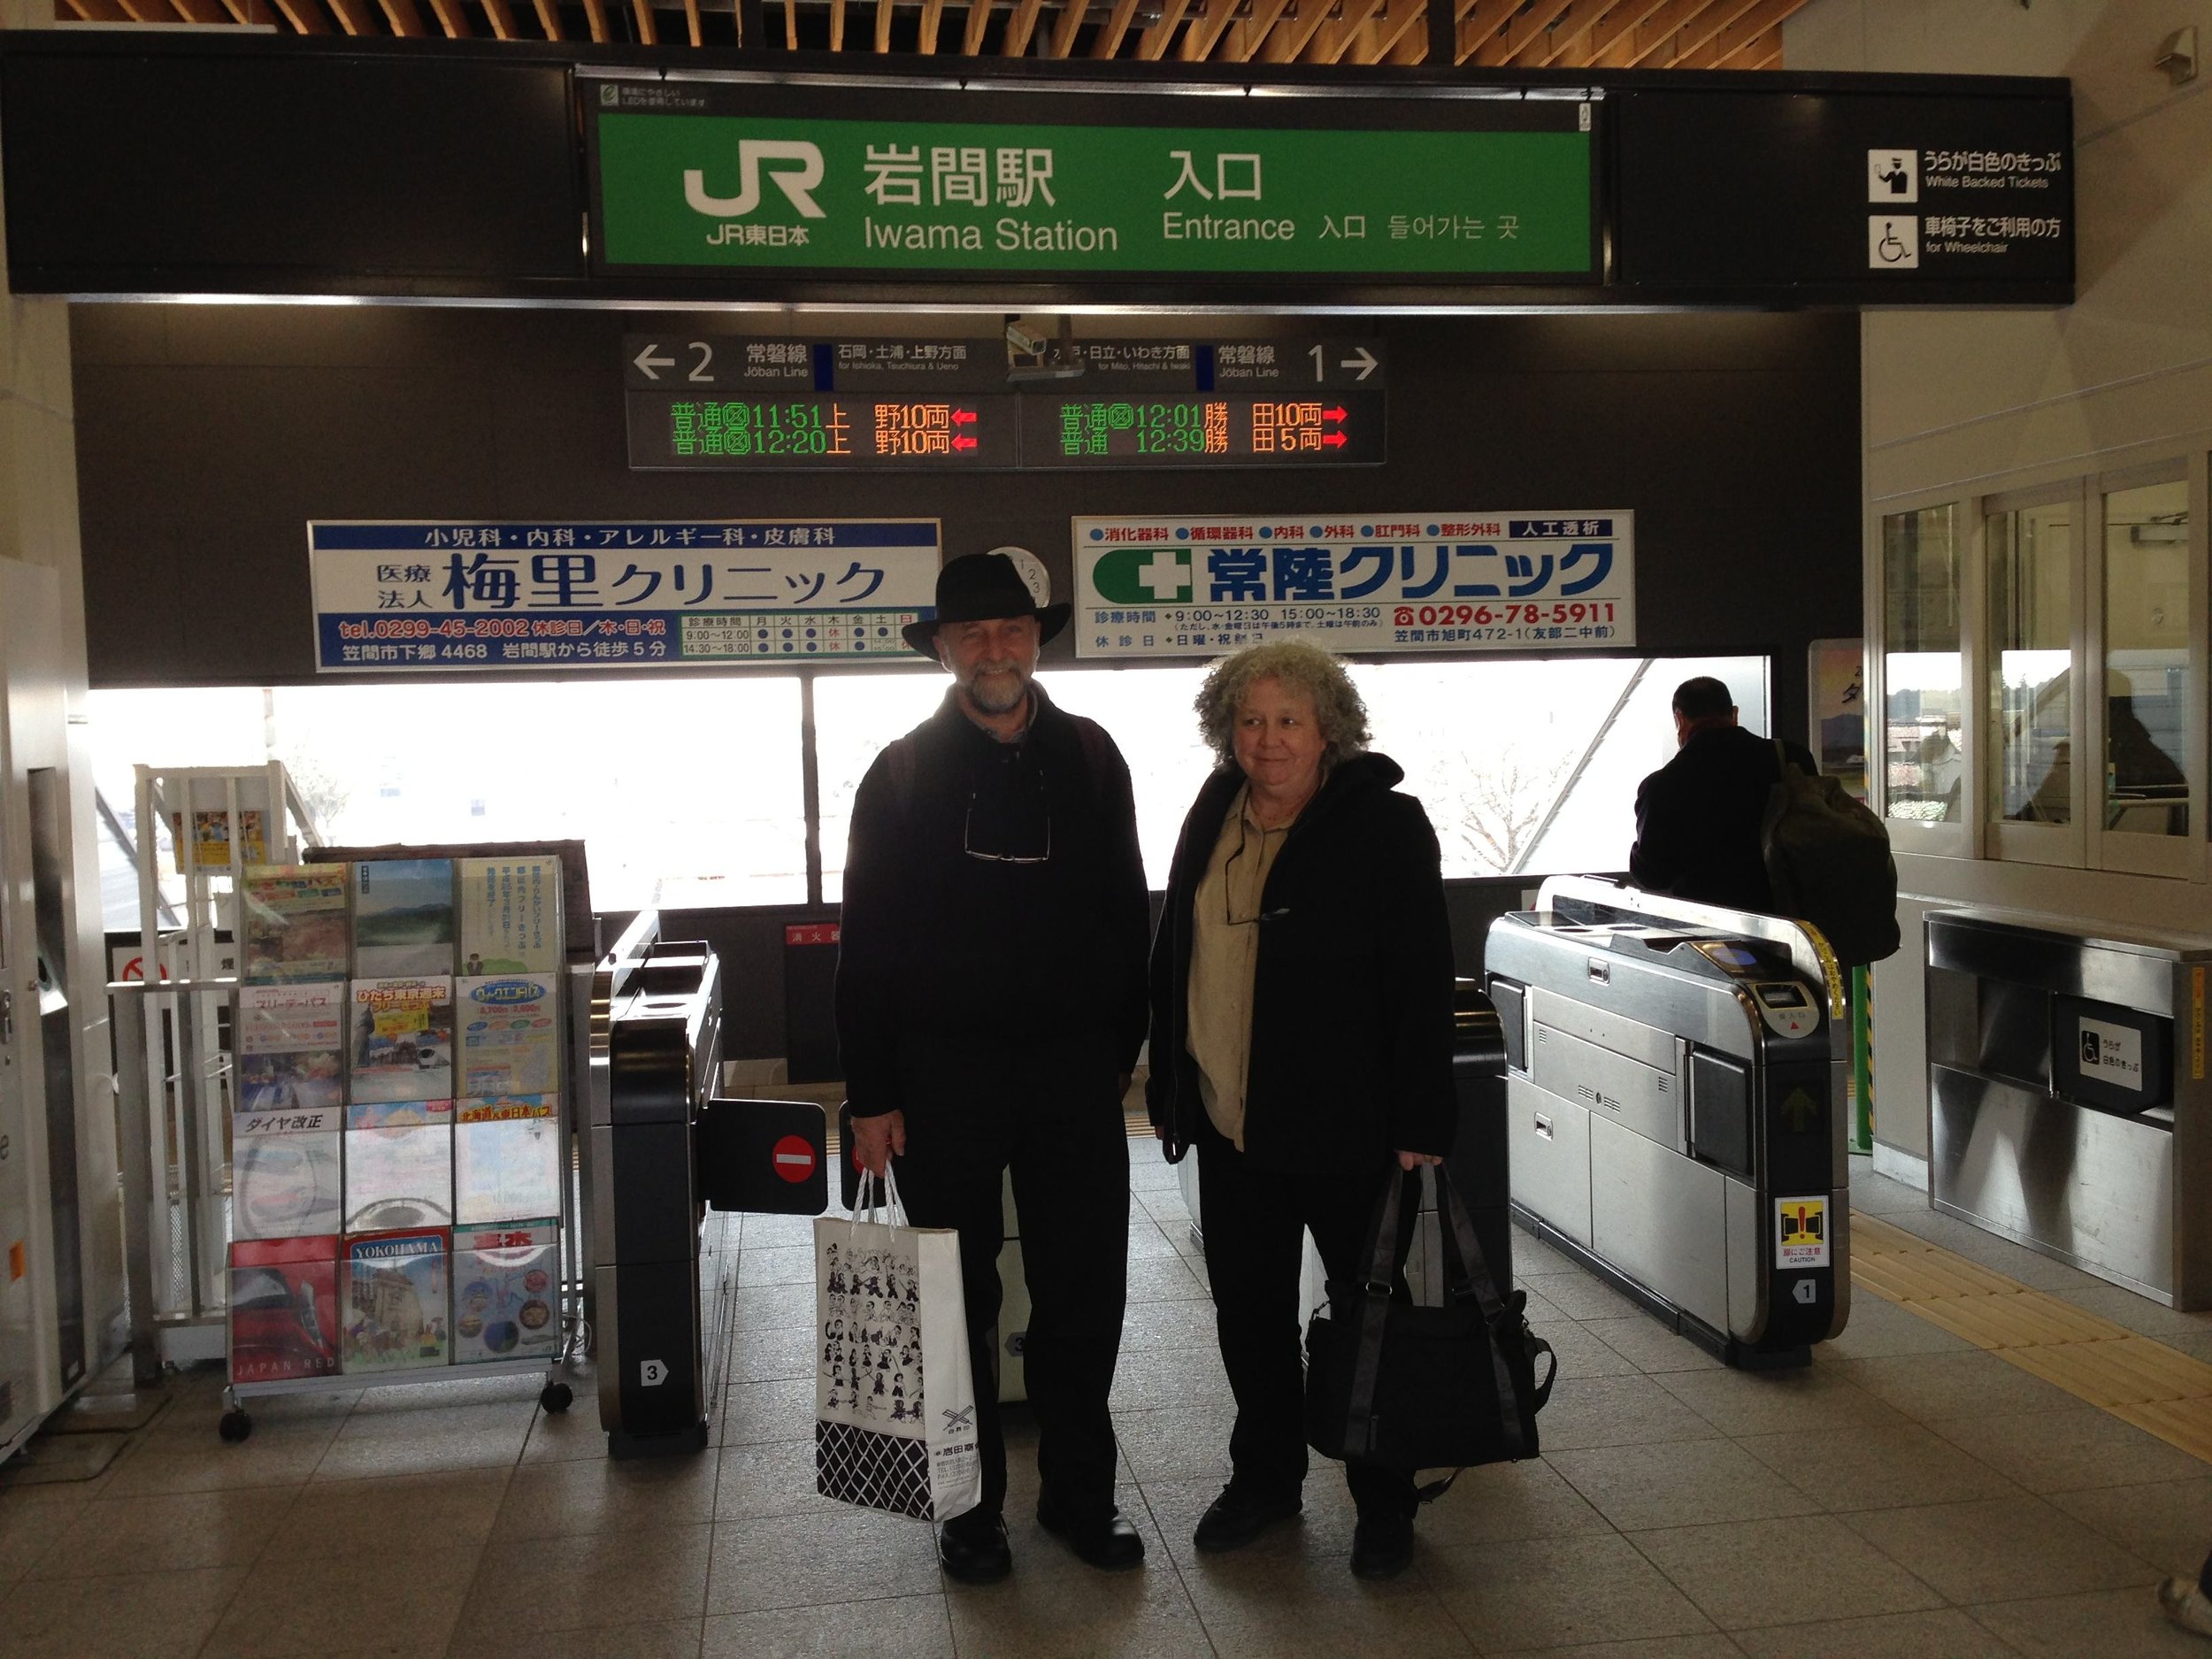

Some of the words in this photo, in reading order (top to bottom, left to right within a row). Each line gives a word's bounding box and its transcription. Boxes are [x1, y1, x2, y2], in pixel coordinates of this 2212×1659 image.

[1924, 150, 2062, 173] うらが白色のきっぷ
[683, 139, 826, 219] JR
[864, 144, 1056, 207] 岩間駅
[1164, 150, 1262, 201] 入口
[1925, 176, 1959, 188] White
[1962, 175, 2005, 188] Backed
[2009, 176, 2049, 189] Tickets
[706, 224, 810, 247] JR東日本
[864, 217, 983, 250] Iwama
[995, 218, 1118, 252] Station
[1163, 211, 1295, 241] Entrance
[1318, 215, 1366, 239] 入口
[1387, 215, 1486, 241] 들어가는
[1496, 215, 1519, 241] 곳
[1924, 215, 2062, 238] 車椅子をご利用の方
[1925, 241, 1941, 252] for
[1944, 241, 2009, 254] Wheelchair
[687, 342, 715, 382] 2
[745, 343, 809, 364] 常磐線
[838, 344, 967, 361] 石岡・土浦・上野方面
[1218, 344, 1274, 364] 常磐線
[1307, 343, 1324, 383] 1
[783, 365, 810, 378] Line
[838, 361, 849, 370] for
[937, 362, 959, 372] Ueno
[1256, 365, 1279, 379] Line
[671, 402, 723, 430] 普通
[753, 403, 823, 428] 11:51
[1059, 403, 1109, 429] 普通
[1136, 403, 1202, 428] 12:01
[672, 429, 723, 455] 普通
[753, 430, 827, 455] 12:20
[1060, 428, 1110, 455] 普通
[1136, 428, 1205, 453] 12:39
[425, 526, 835, 547] 小児科・内科・アレルギー科・皮膚科
[1104, 527, 1169, 541] 消化器科
[1190, 526, 1254, 541] 循環器科
[1273, 526, 1304, 539] 内科
[1324, 525, 1355, 539] 外科
[1375, 524, 1420, 538] 肛門科
[1440, 522, 1502, 537] 整形外科
[1522, 520, 1601, 536] 人工透析
[377, 565, 432, 583] 医療
[442, 552, 885, 610] 梅里クリニック
[1207, 543, 1613, 603] 常陸クリニック
[378, 589, 433, 609] 法人
[688, 617, 741, 627] 診療時間
[757, 614, 767, 626] 月
[780, 614, 792, 626] 火
[804, 614, 816, 626] 水
[828, 613, 840, 625] 木
[852, 613, 864, 625] 金
[876, 614, 887, 624] 土
[900, 614, 912, 624] 日
[1094, 611, 1156, 624] 診療時間
[1418, 603, 1614, 626] 0296-78-5911
[828, 628, 840, 639] 休
[1095, 634, 1155, 648] 休診日
[342, 643, 436, 662] 笠間市下郷
[441, 644, 488, 659] 4468
[829, 640, 841, 651] 休
[792, 930, 841, 942] 消火器
[2102, 1039, 2121, 1052] うらが
[2102, 1055, 2139, 1073] 白色のきっぷ
[245, 1114, 322, 1133] ダイヤ改正
[355, 1241, 439, 1259] YOKOHAMA
[1803, 1284, 1809, 1299] 1
[237, 1359, 292, 1377] JAPAN
[303, 1356, 336, 1370] RED
[647, 1365, 658, 1380] 3
